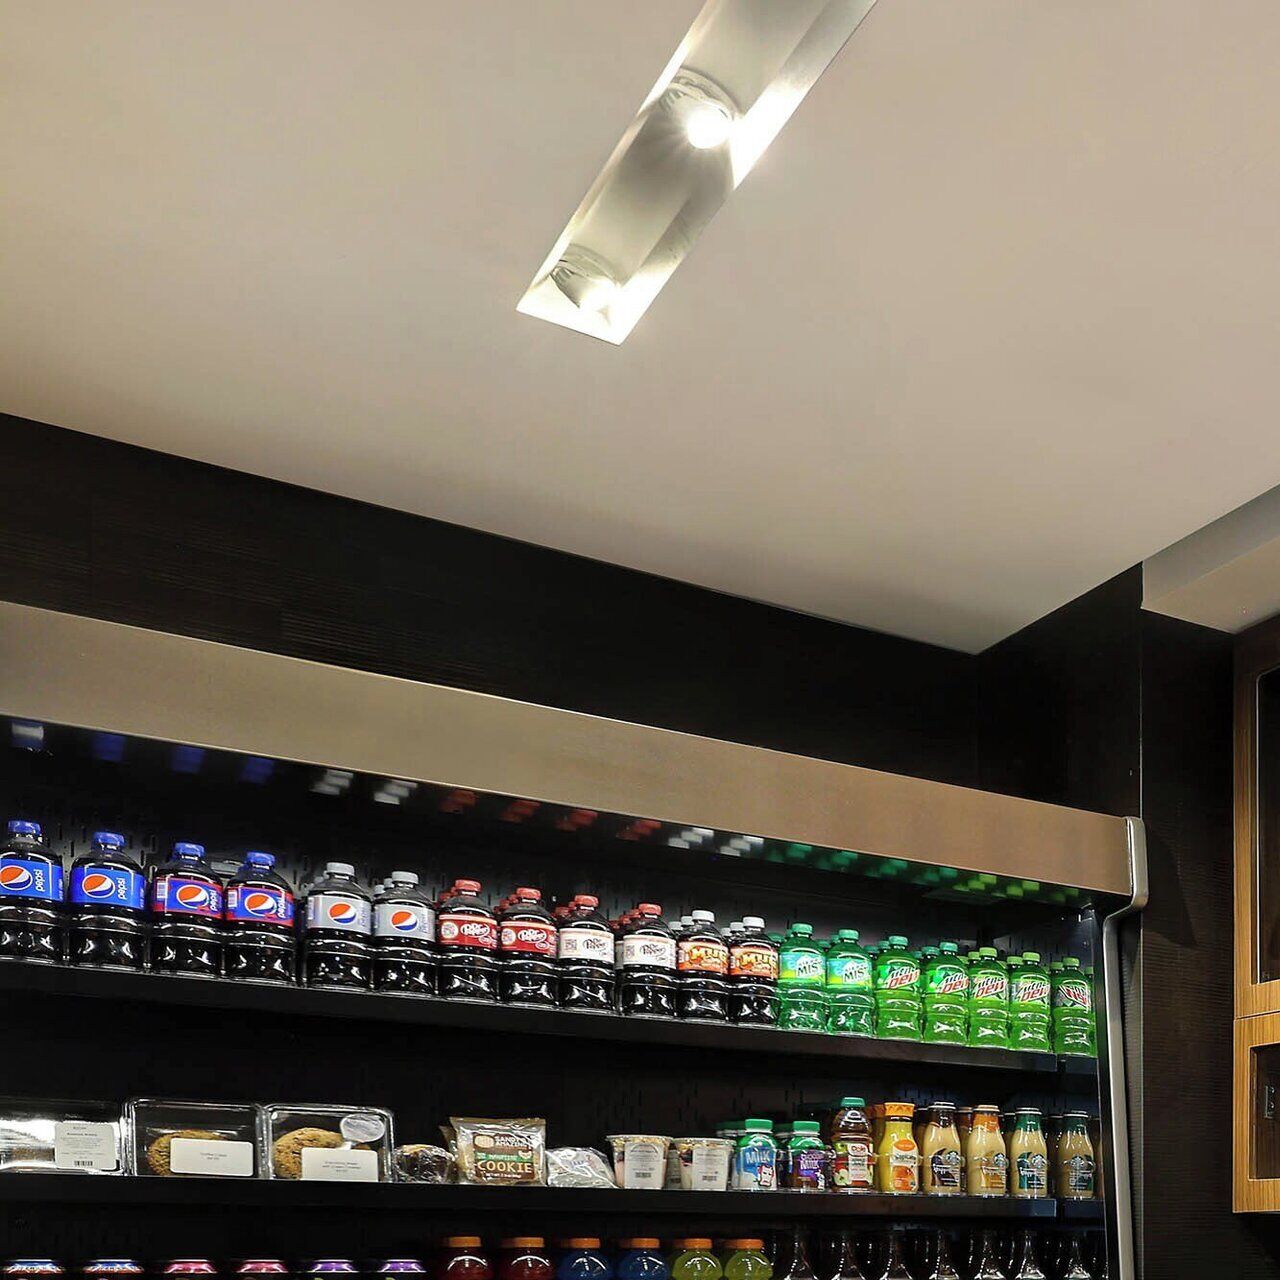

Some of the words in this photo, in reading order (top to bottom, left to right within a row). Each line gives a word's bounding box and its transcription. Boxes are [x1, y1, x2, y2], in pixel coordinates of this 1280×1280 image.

[34, 869, 45, 892] pepsi
[118, 877, 127, 900] pepsi
[211, 889, 219, 911] pepsi
[746, 1150, 771, 1164] MILK
[850, 1145, 866, 1153] Dole
[478, 1160, 532, 1173] COOKIE
